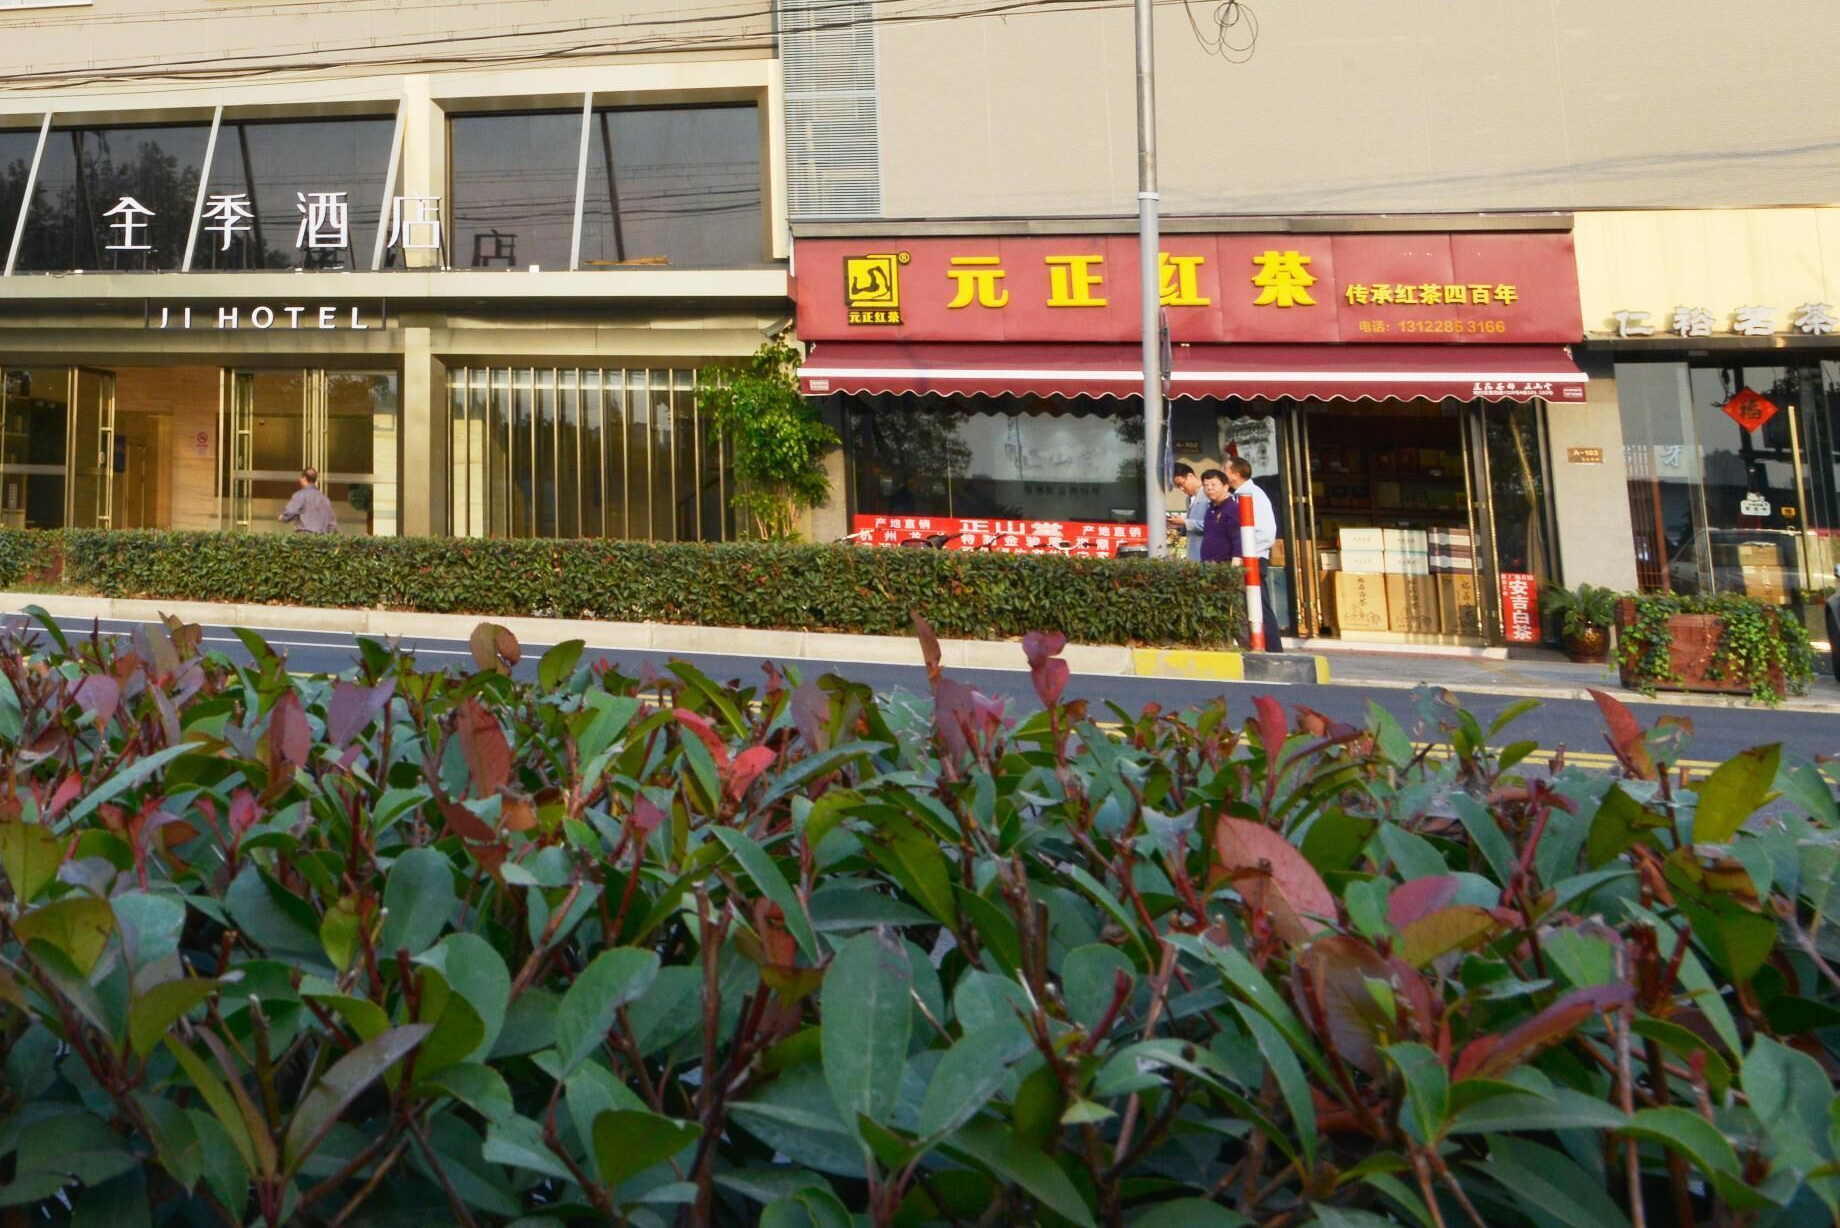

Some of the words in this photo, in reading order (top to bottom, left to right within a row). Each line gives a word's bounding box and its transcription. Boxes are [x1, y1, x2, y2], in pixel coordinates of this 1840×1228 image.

[102, 191, 443, 252] 全季酒店
[947, 249, 1317, 309] 元正红茶
[1345, 283, 1519, 305] 传承红茶四百年
[160, 306, 191, 329] JI
[218, 306, 369, 329] HOTEL
[849, 311, 901, 323] 元正红茶
[1738, 398, 1763, 421] 福
[874, 517, 931, 530] 产地直销
[959, 520, 1064, 537] 正山堂
[1082, 526, 1142, 538] 产地直销
[1508, 579, 1533, 640] 安吉白茶
